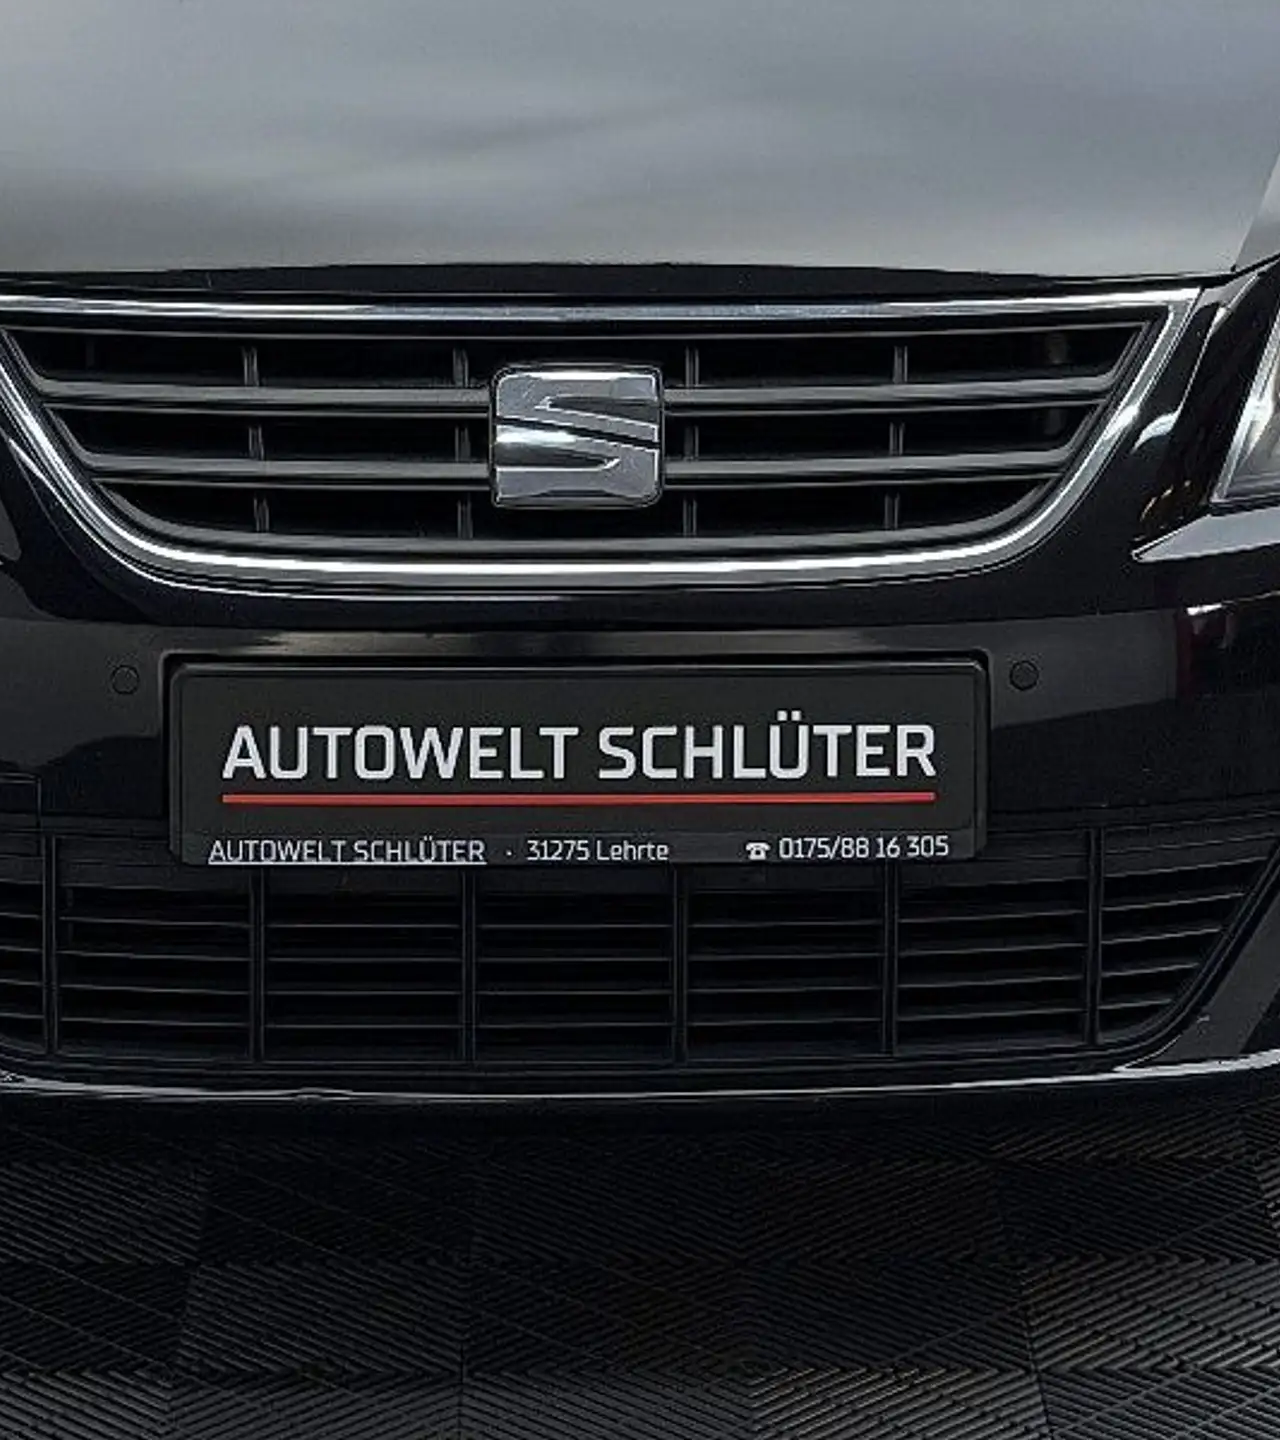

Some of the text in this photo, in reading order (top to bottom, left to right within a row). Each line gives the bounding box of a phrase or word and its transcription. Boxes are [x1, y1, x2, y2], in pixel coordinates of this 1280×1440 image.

[222, 710, 937, 780] AUTOWELT SCHLÜTER
[209, 835, 949, 862] AUTOWELT SCHLÜTER 31275 Lehrte 0175/88 16 305
